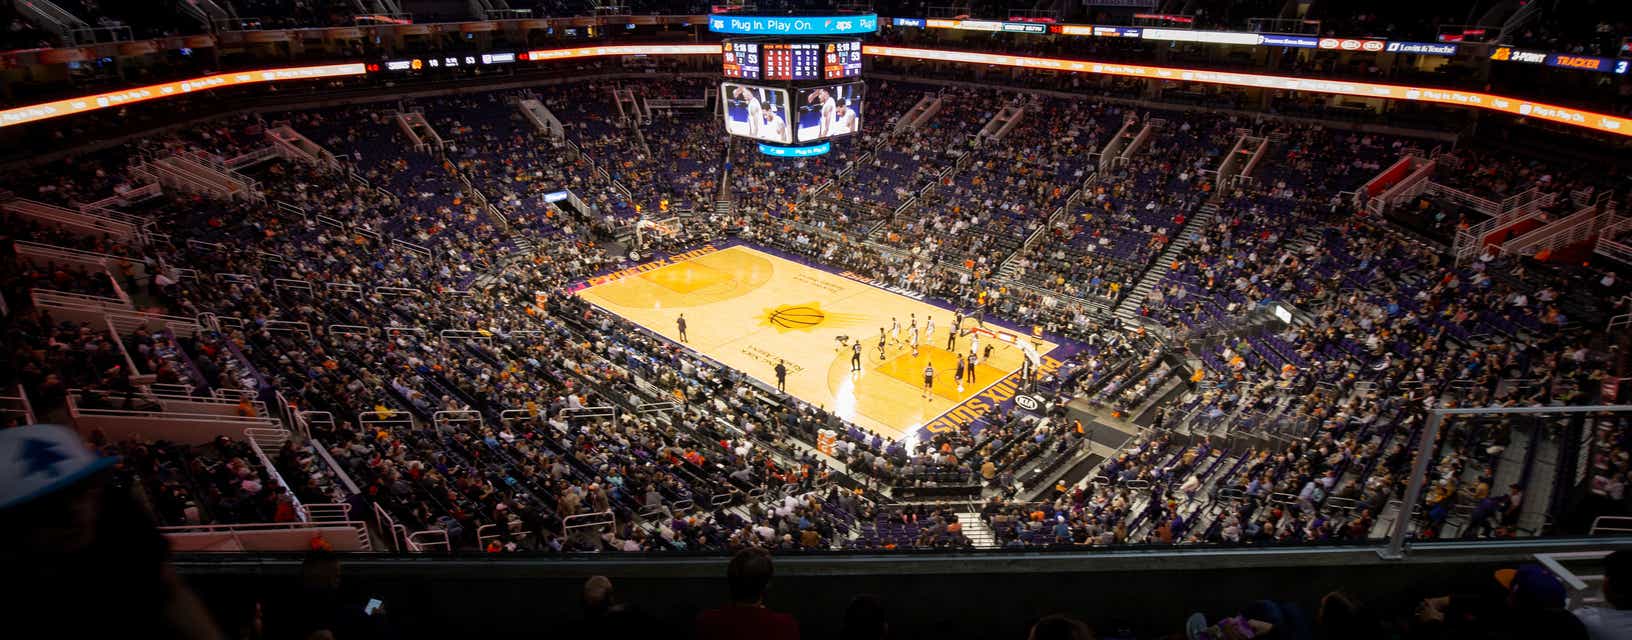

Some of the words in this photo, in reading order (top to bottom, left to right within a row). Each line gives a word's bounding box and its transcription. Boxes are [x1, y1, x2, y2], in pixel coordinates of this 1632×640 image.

[731, 19, 751, 31] Plug
[768, 20, 791, 32] Play
[836, 21, 852, 31] aps
[836, 43, 850, 52] 5:18
[748, 53, 758, 64] 53
[851, 51, 860, 62] 53
[1556, 55, 1600, 69] TRACKER
[1615, 61, 1628, 73] 3
[1019, 397, 1034, 408] KIA
